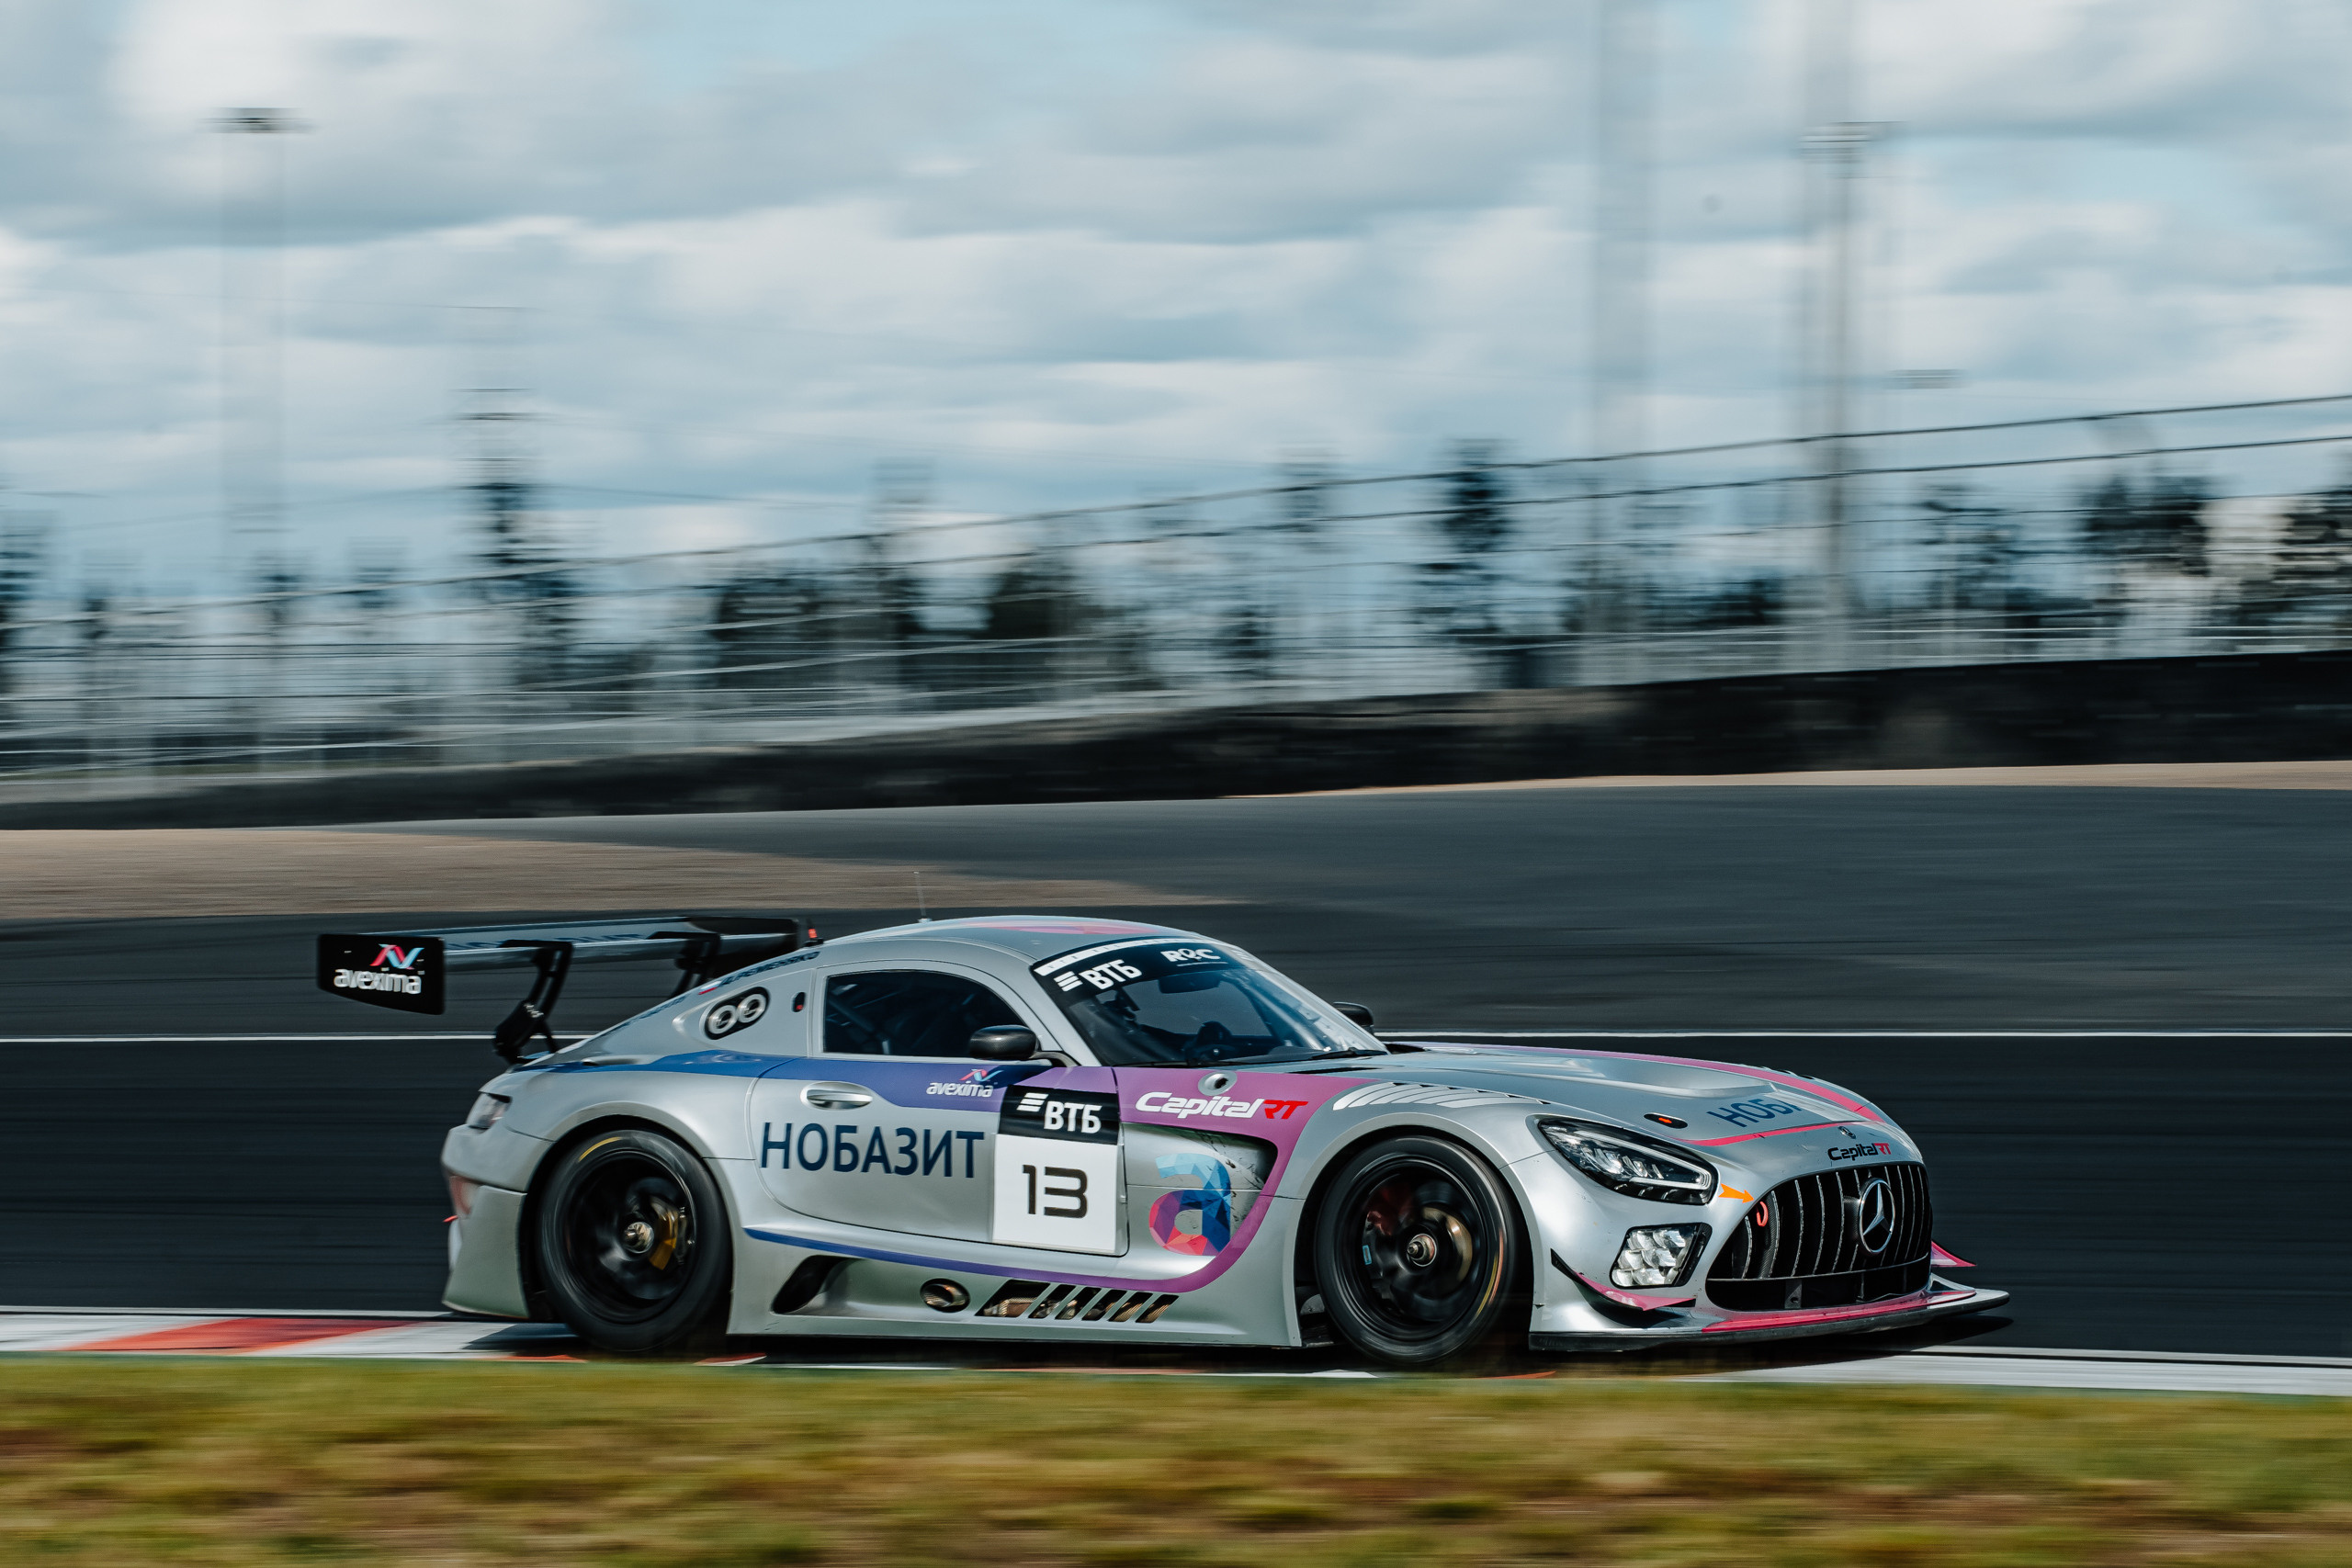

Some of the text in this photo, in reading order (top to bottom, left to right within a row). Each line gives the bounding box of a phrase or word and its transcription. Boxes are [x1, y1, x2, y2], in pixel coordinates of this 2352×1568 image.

[334, 967, 422, 994] avexima
[1079, 959, 1142, 989] ВТБ
[926, 1080, 993, 1097] avexima
[1044, 1100, 1102, 1134] ВТБ
[761, 1122, 985, 1179] НОБАЗИТ
[1023, 1165, 1088, 1219] 13
